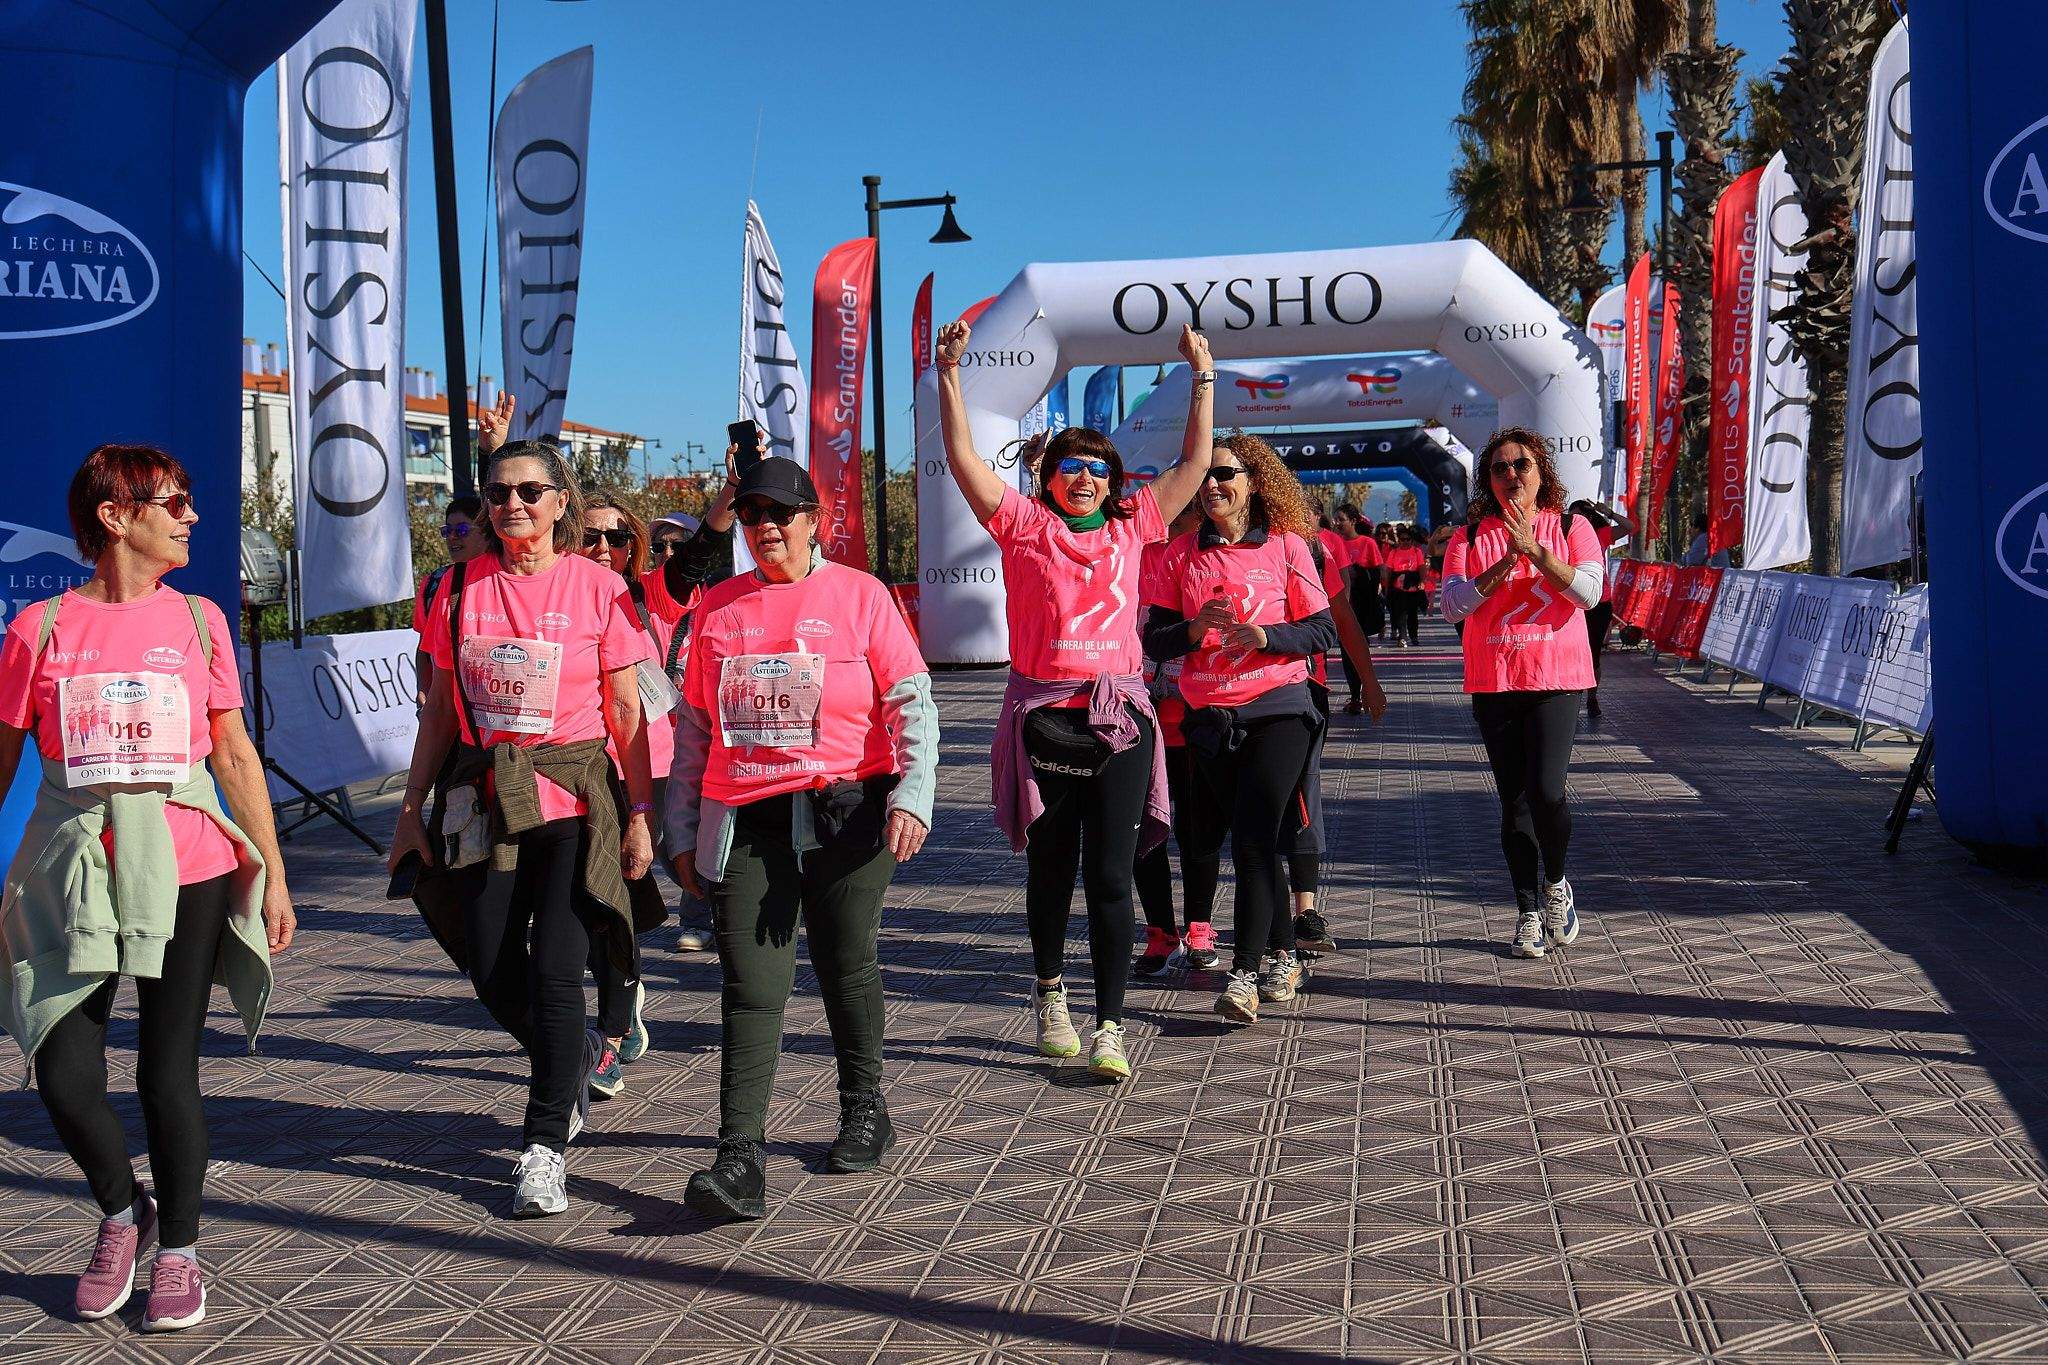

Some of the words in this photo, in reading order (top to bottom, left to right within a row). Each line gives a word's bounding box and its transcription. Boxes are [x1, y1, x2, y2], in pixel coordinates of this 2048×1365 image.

[12, 236, 125, 257] LECHERA
[302, 45, 395, 518] OYSHO
[513, 138, 581, 440] YSHO
[1729, 212, 1757, 375] Santander
[1112, 270, 1384, 337] OYSHO
[1464, 321, 1547, 344] OYSHO
[834, 278, 859, 424] Santander
[956, 350, 1035, 369] OYSHO
[1236, 403, 1291, 413] TotalEnergies
[1347, 398, 1403, 407] TotalEnergies
[1274, 441, 1392, 457] VOLVO
[1720, 425, 1744, 522] Sports
[925, 567, 996, 584] OYSHO
[1050, 639, 1083, 650] CARRERA
[1085, 640, 1095, 650] DE
[1097, 640, 1105, 650] LA
[492, 651, 526, 661] ASTURIANA
[753, 666, 788, 675] ASTURIANA
[1239, 669, 1264, 681] MUJER
[104, 688, 147, 699] ASTURIANA
[489, 679, 525, 696] 016
[753, 693, 791, 710] 016
[108, 721, 153, 740] 016
[510, 719, 541, 728] Santander
[781, 734, 812, 742] Santander
[81, 756, 109, 764] CARRERA
[780, 764, 790, 773] LA
[793, 760, 826, 772] MUJER
[1030, 755, 1093, 777] adidas
[80, 767, 120, 779] OYSHO
[140, 768, 176, 777] Santander
